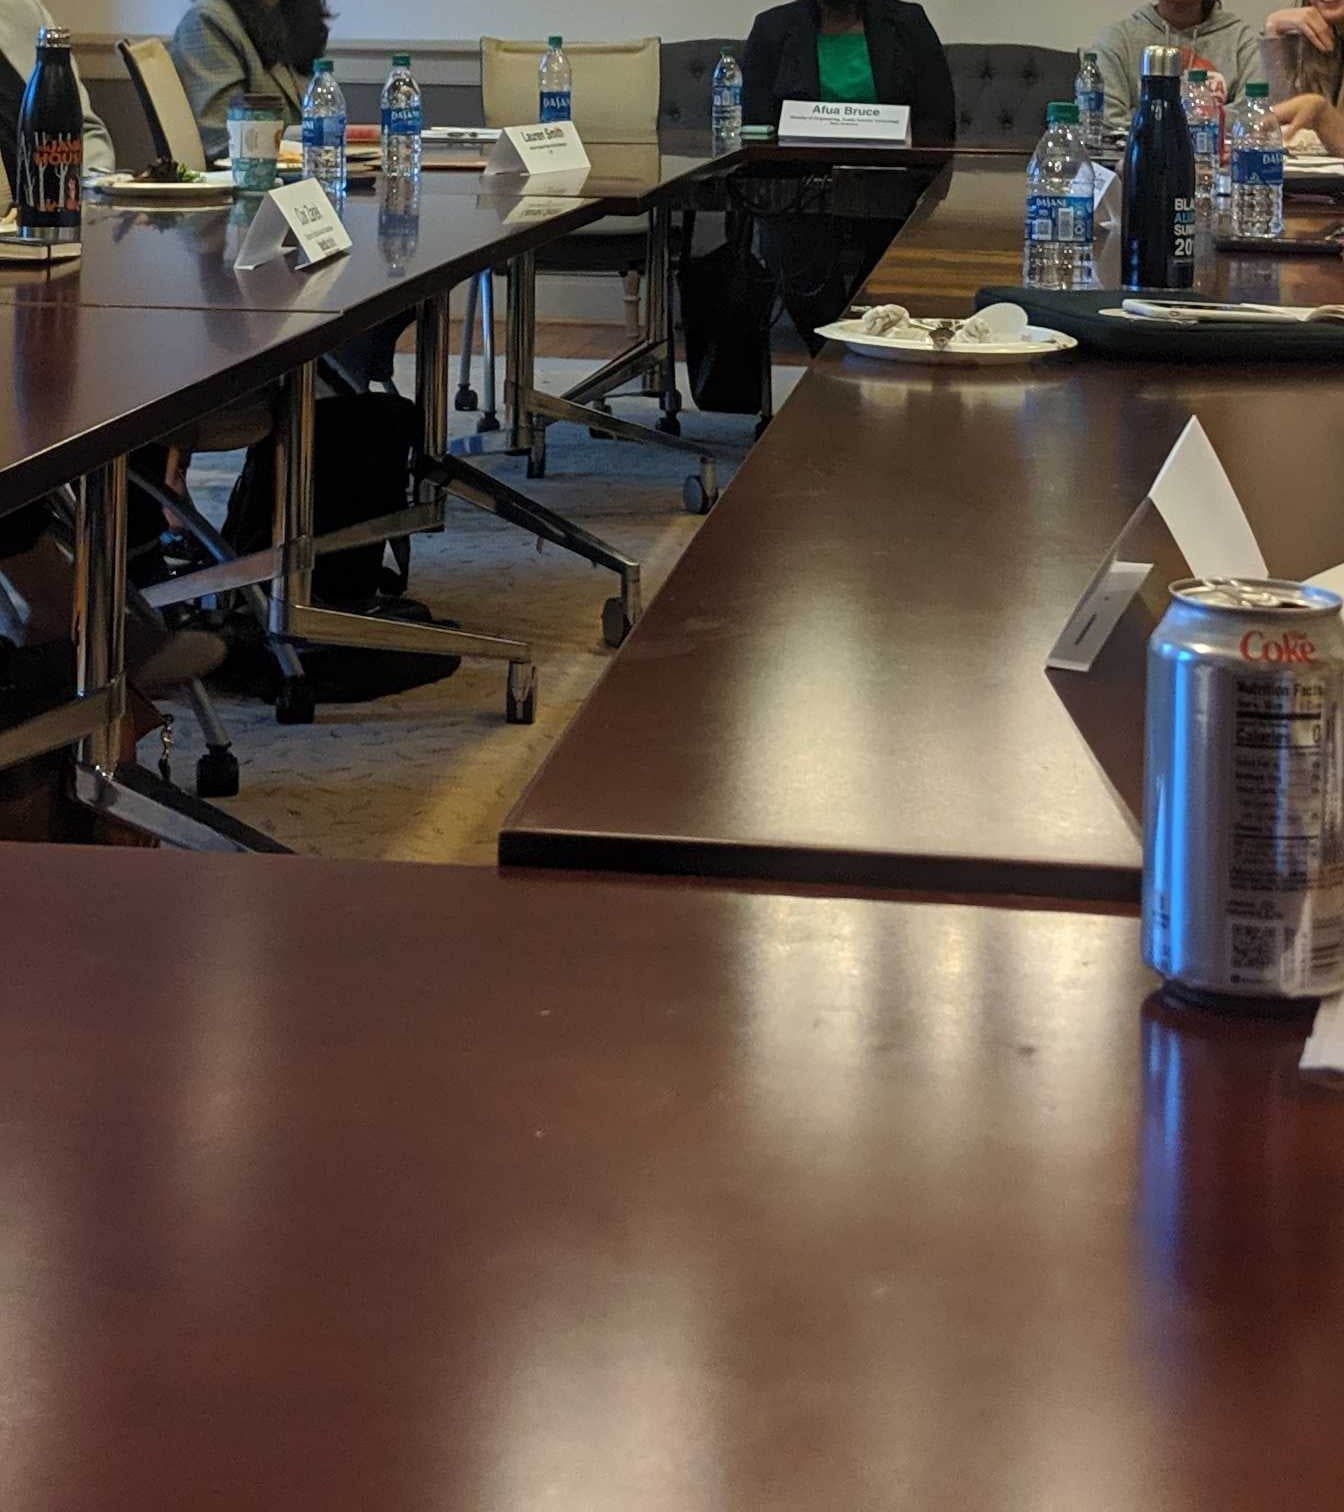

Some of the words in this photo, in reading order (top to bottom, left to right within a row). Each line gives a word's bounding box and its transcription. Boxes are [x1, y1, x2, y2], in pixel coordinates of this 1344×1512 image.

[812, 104, 841, 115] Afua
[844, 106, 881, 117] Bruce
[1239, 630, 1318, 665] Coke
